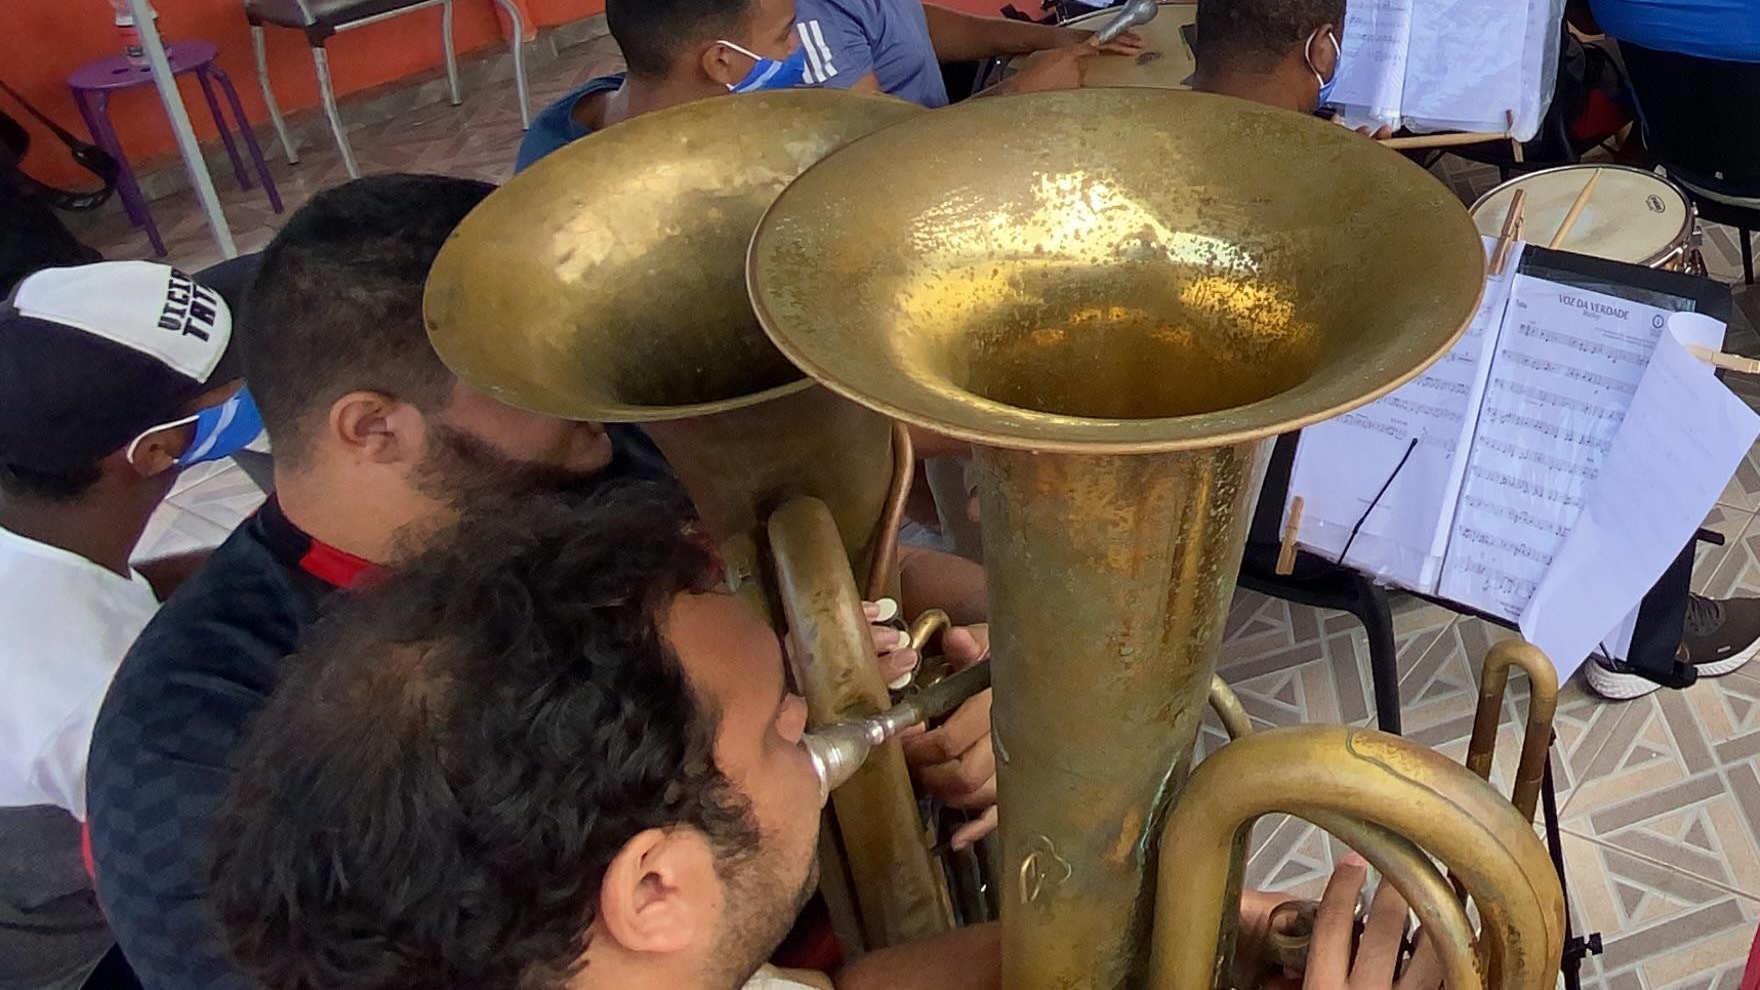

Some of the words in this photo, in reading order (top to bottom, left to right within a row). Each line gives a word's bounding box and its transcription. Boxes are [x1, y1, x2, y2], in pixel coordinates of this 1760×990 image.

[1558, 294, 1576, 306] VOZ
[1576, 297, 1589, 310] DA
[1589, 302, 1631, 321] VERDADE
